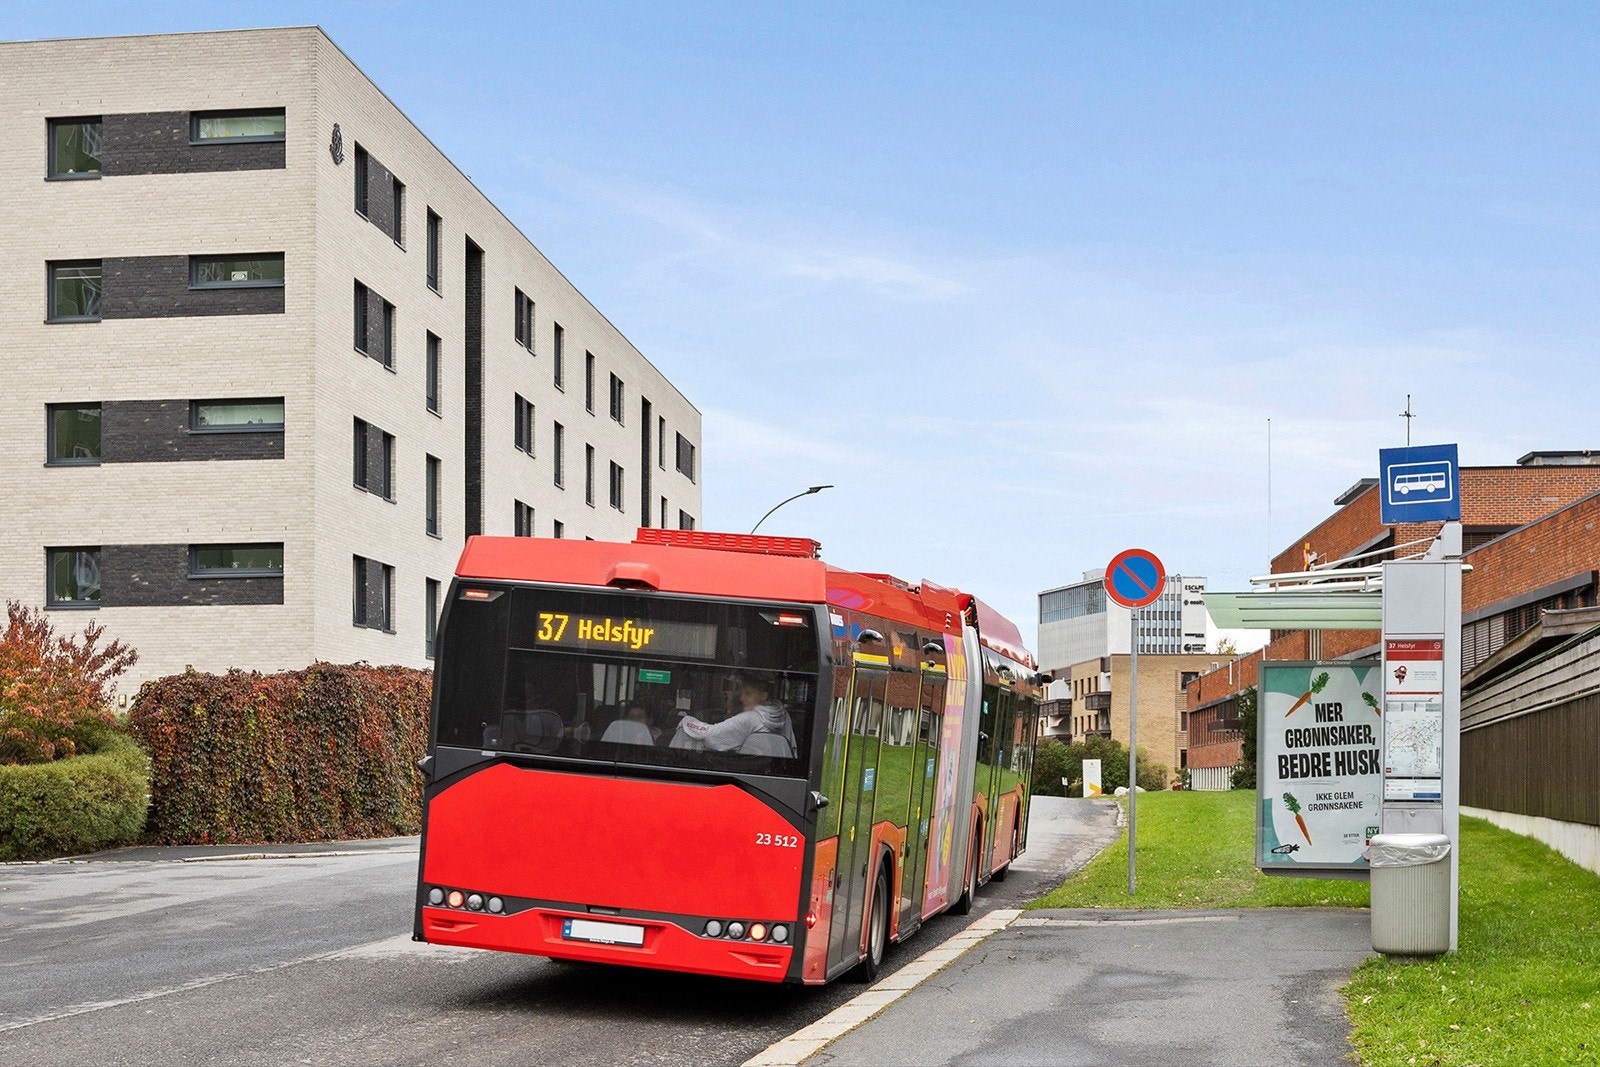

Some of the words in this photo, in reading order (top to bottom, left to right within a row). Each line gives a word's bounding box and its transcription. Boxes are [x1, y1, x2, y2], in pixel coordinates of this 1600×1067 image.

[537, 613, 569, 641] 37
[577, 618, 654, 650] Helsfyr
[1315, 702, 1343, 723] MER
[1285, 724, 1376, 749] GRØNNSAKER,
[1278, 752, 1332, 780] BEDRE
[1334, 748, 1380, 777] HUSK
[1308, 801, 1363, 812] GRØNNSAKENE
[1316, 793, 1333, 801] IKKE
[1334, 791, 1354, 800] GLEM
[755, 832, 772, 846] 23
[774, 834, 798, 848] 512
